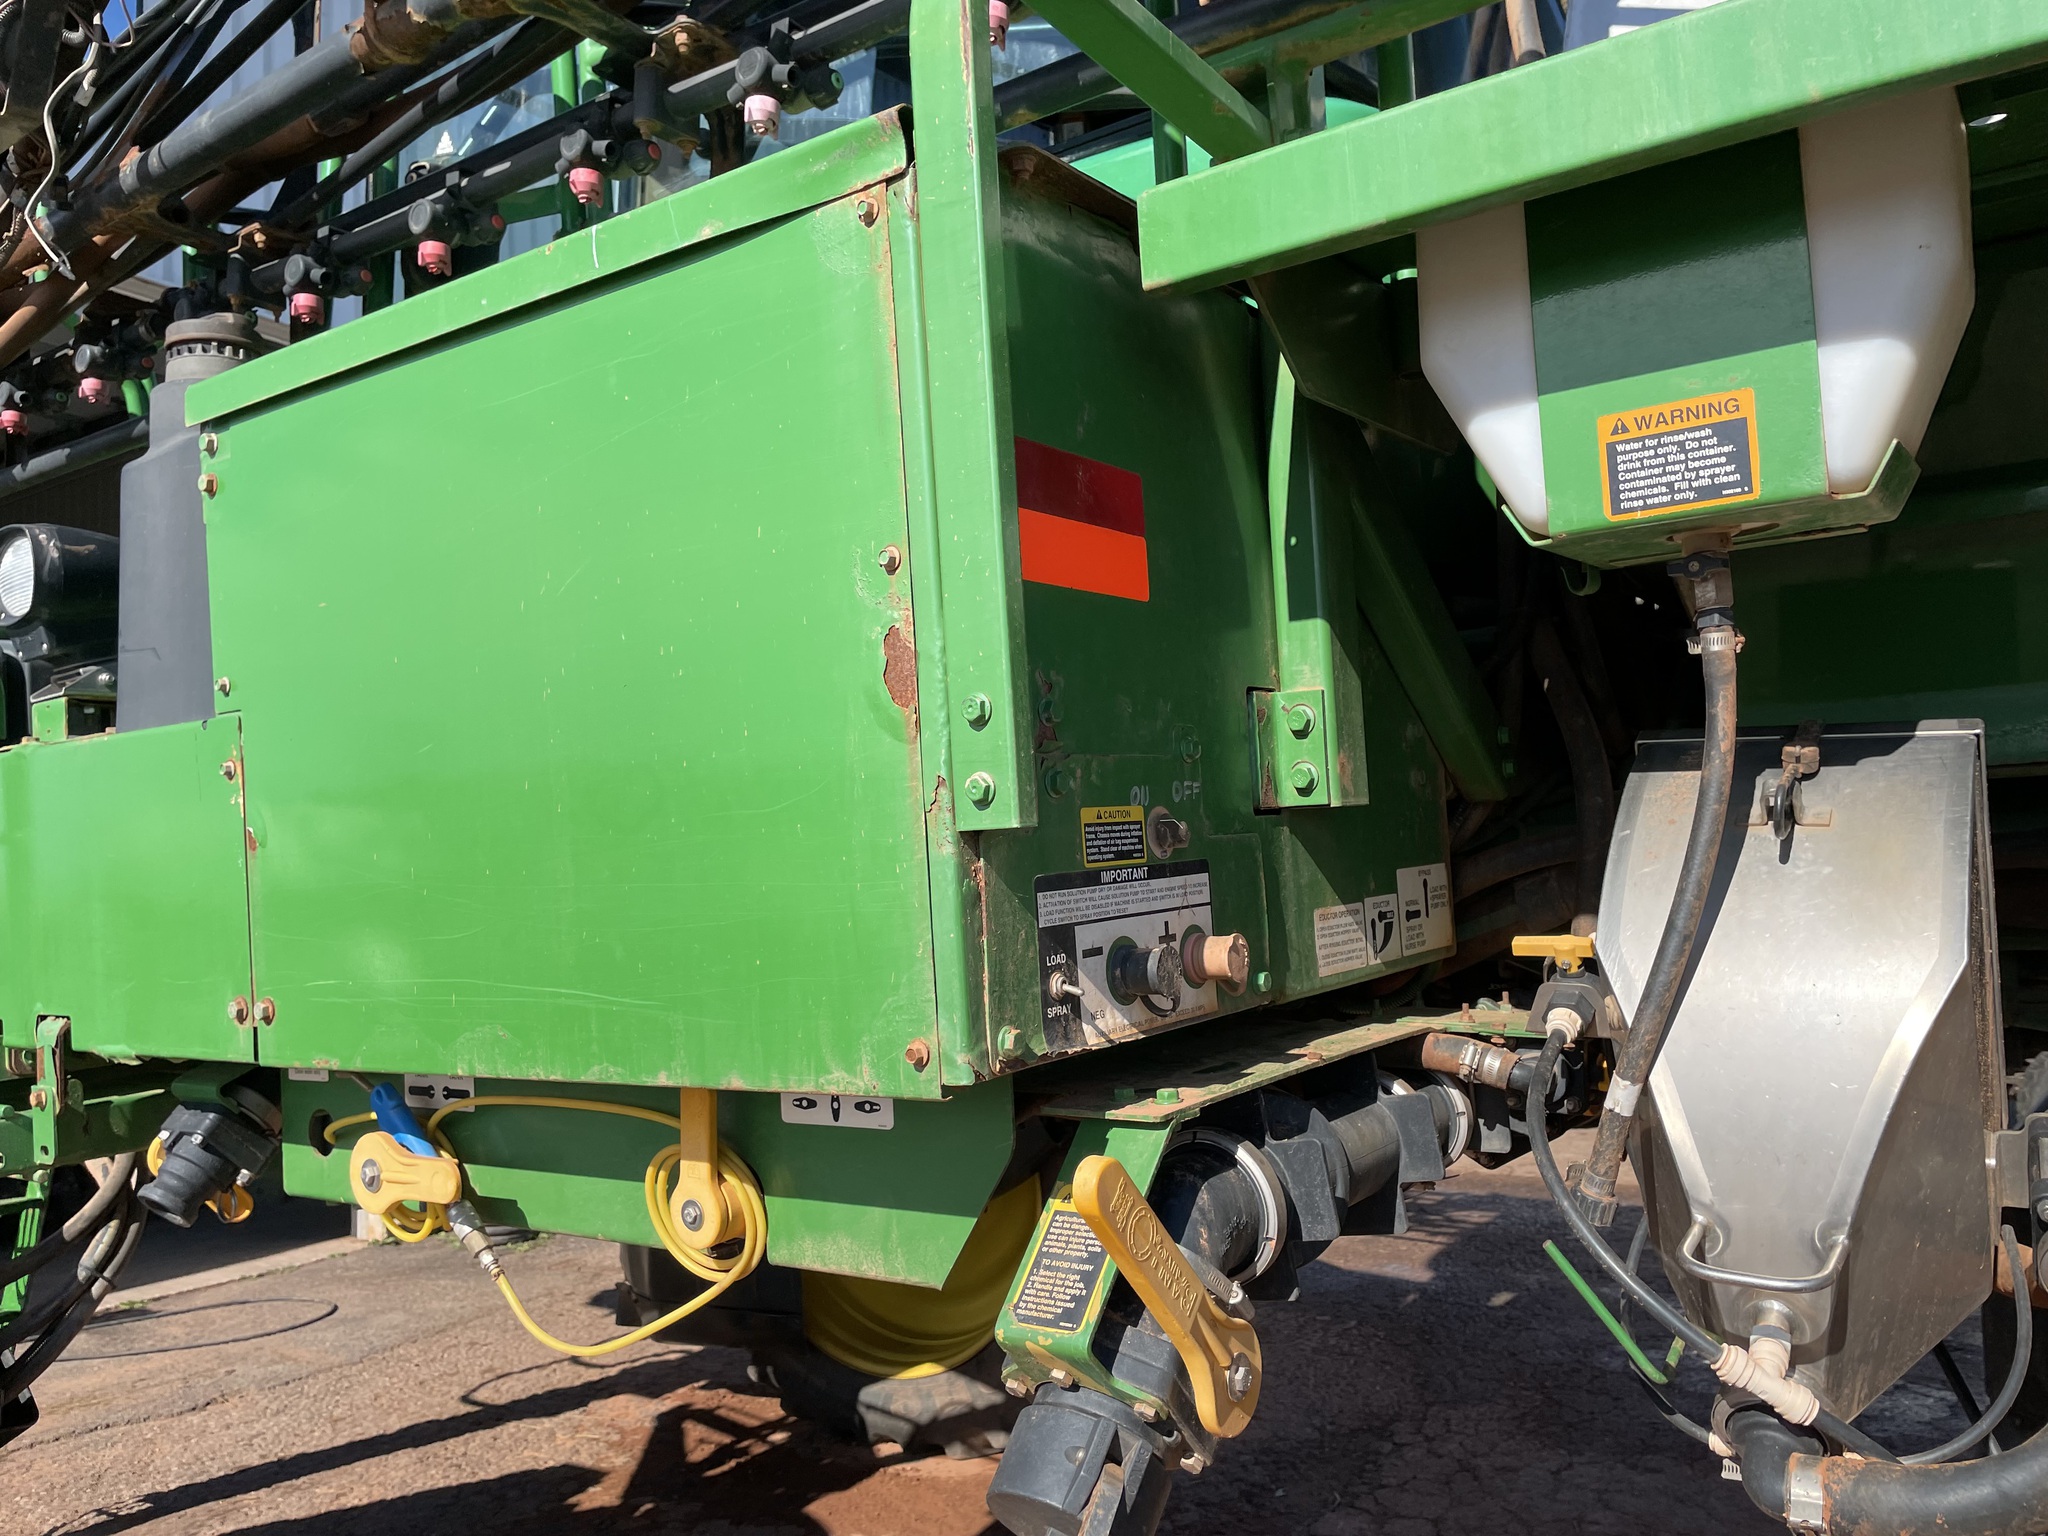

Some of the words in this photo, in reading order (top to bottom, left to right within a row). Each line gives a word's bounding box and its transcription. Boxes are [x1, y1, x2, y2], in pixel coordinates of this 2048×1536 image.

[1634, 398, 1740, 430] WARNING
[1616, 442, 1643, 452] Water
[1645, 439, 1658, 448] for
[1660, 428, 1712, 444] rinse/wash
[1616, 450, 1655, 464] purpose
[1657, 444, 1680, 454] only.
[1685, 441, 1700, 450] Do
[1701, 436, 1718, 446] not
[1618, 461, 1641, 471] drink
[1644, 457, 1665, 467] from
[1668, 453, 1686, 462] this
[1688, 445, 1736, 458] container.
[1618, 467, 1664, 480] Container
[1666, 463, 1686, 473] may
[1688, 456, 1726, 468] become
[1619, 472, 1682, 490] contaminated
[1684, 471, 1696, 480] by
[1698, 464, 1736, 478] sprayer
[1620, 485, 1670, 500] chemicals.
[1674, 480, 1689, 490] Fill
[1691, 478, 1712, 488] with
[1714, 474, 1740, 484] clean
[1620, 500, 1644, 510] rinse
[1646, 495, 1672, 505] water
[1674, 491, 1698, 500] only.
[1172, 780, 1200, 802] OFF
[1104, 810, 1130, 820] CAUTION
[1100, 867, 1148, 883] IMPORTANT
[1046, 954, 1066, 966] LOAD
[1047, 1004, 1072, 1018] SPRAY
[1090, 1010, 1105, 1020] NEG
[1054, 1214, 1086, 1224] Agricultura
[1044, 1240, 1066, 1248] animals,
[1069, 1236, 1086, 1245] injure
[1048, 1246, 1064, 1254] other
[1064, 1250, 1088, 1258] property.
[1050, 1260, 1070, 1268] AVOID
[1070, 1262, 1094, 1272] INJURY
[1030, 1276, 1055, 1284] chemical
[1039, 1269, 1056, 1277] Select
[1066, 1272, 1080, 1281] right
[1033, 1282, 1053, 1291] Handle
[1064, 1288, 1082, 1296] apply
[1036, 1290, 1050, 1298] care.
[1052, 1292, 1072, 1300] Follow
[1016, 1308, 1055, 1320] manufacturer.
[1036, 1304, 1063, 1314] chemical
